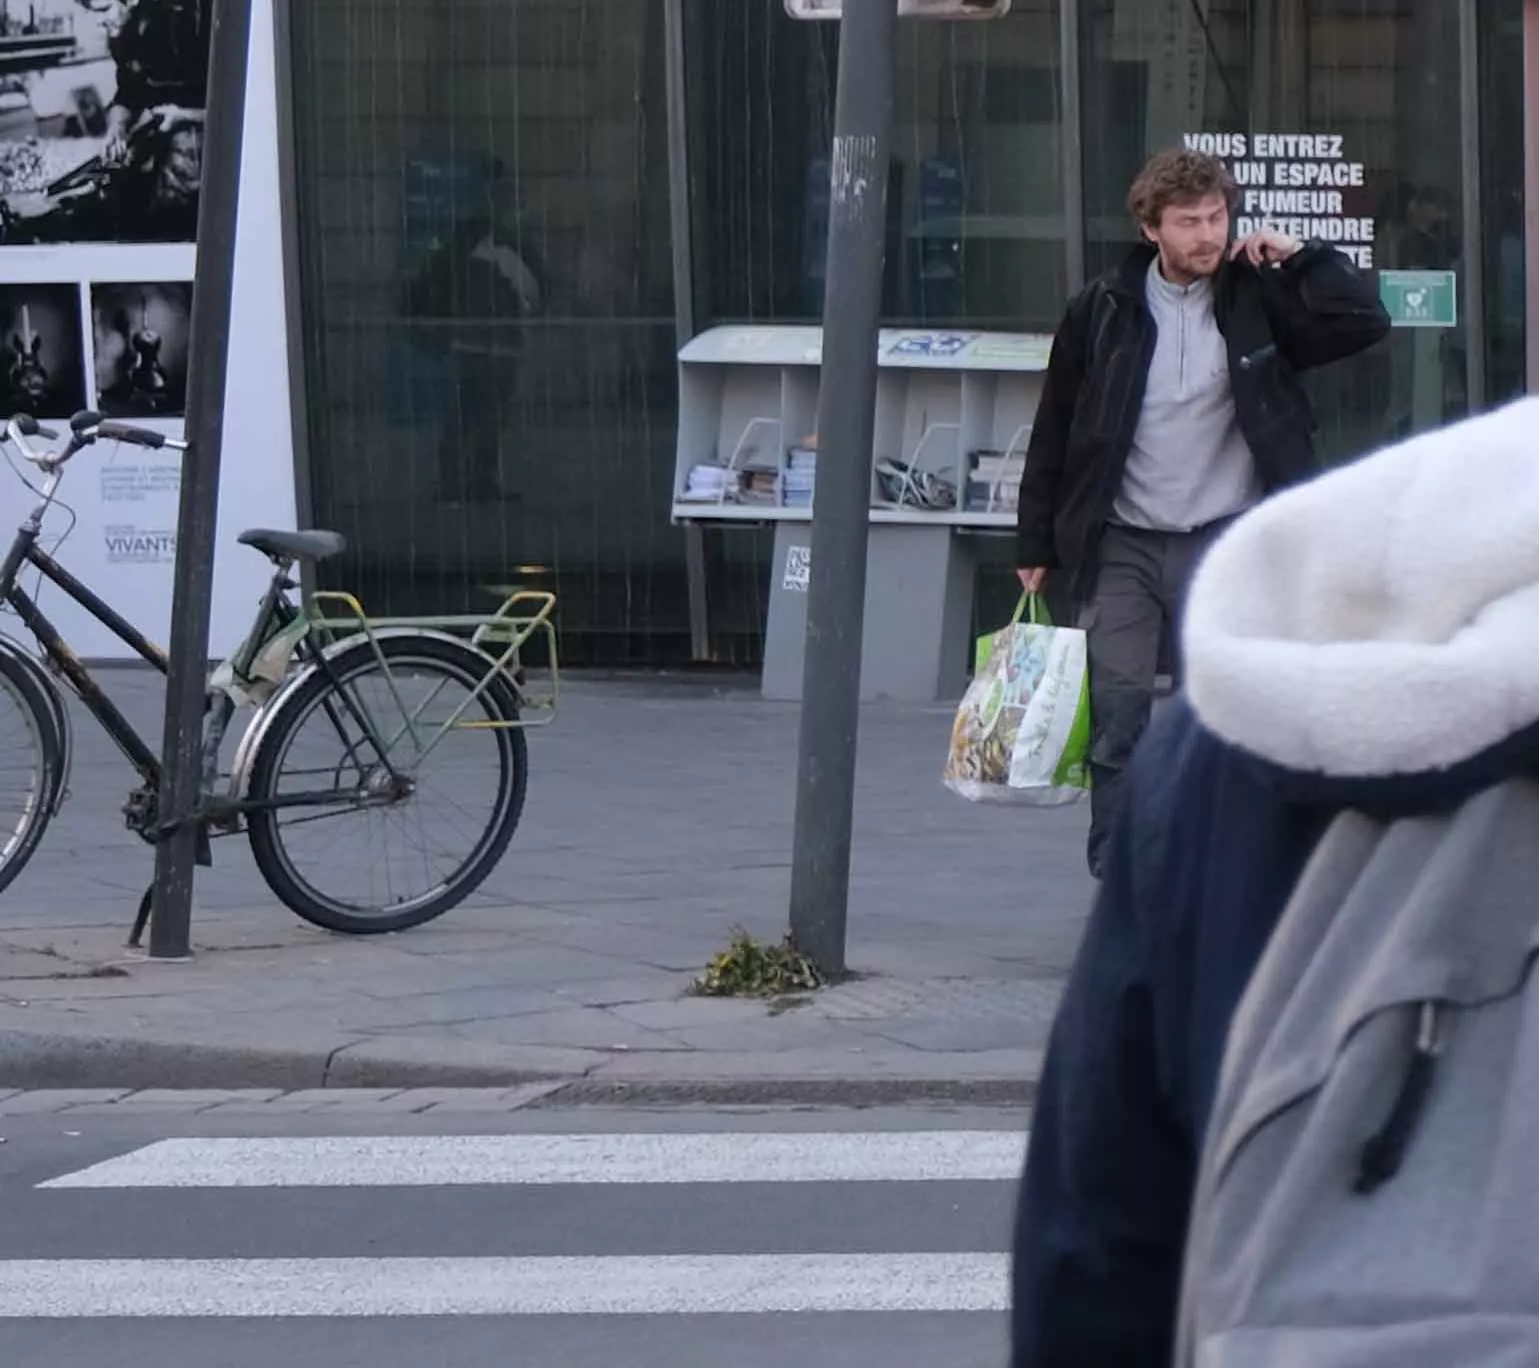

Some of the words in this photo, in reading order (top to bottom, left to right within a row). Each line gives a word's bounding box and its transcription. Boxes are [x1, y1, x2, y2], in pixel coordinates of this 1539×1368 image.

[1183, 133, 1248, 159] VOUS
[1253, 134, 1345, 159] ENTREZ
[1233, 162, 1266, 186] UN
[1273, 163, 1365, 187] ESPACE
